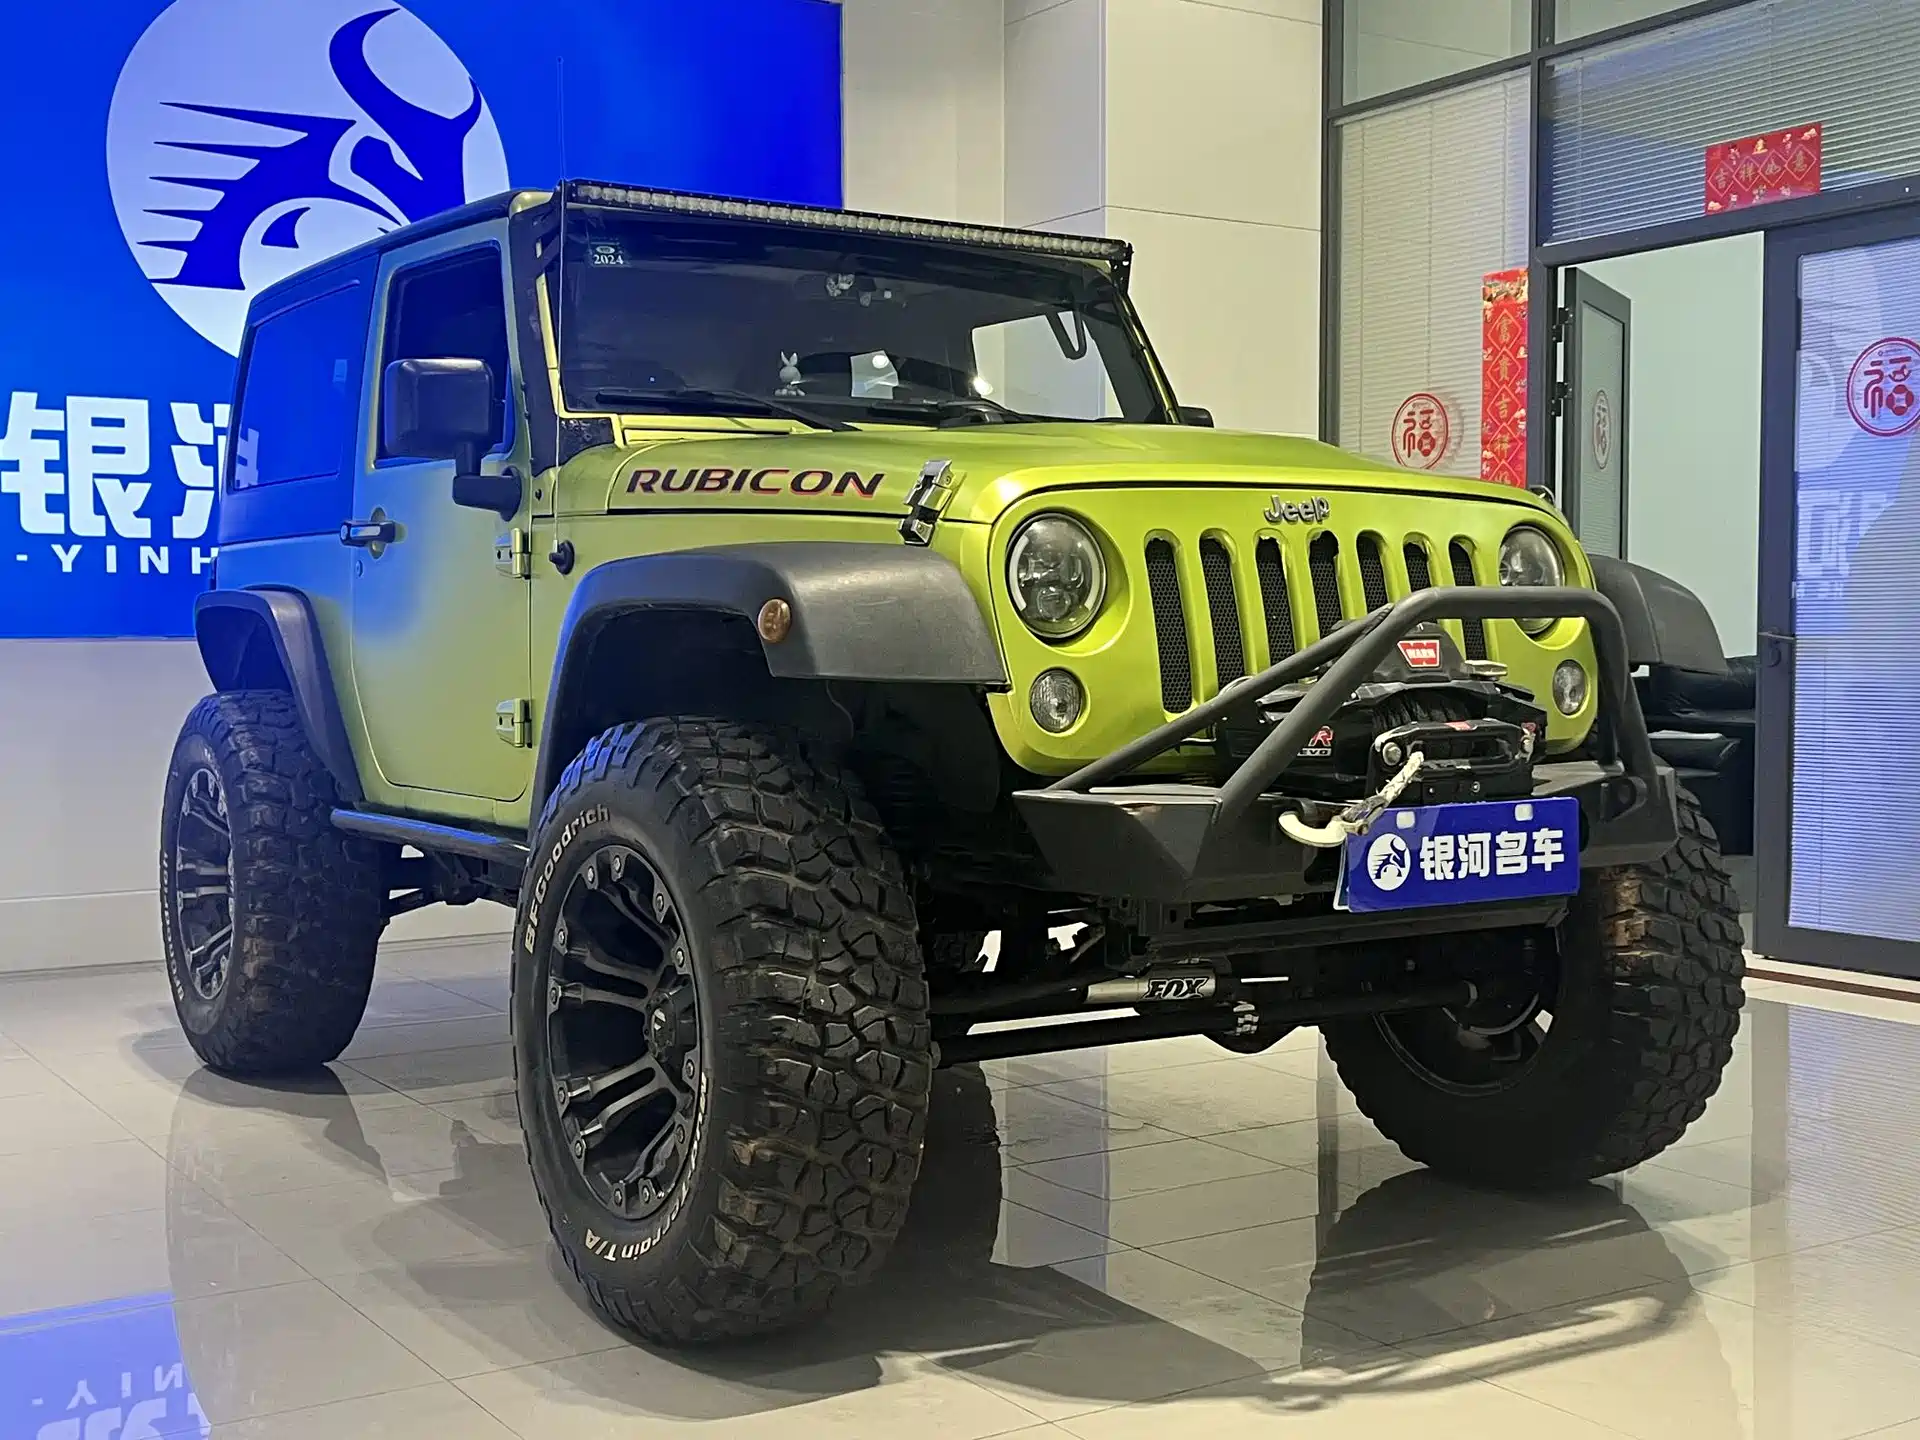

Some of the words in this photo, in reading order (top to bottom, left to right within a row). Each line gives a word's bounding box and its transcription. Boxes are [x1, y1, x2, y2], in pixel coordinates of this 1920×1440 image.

[593, 254, 624, 265] 2024
[625, 468, 885, 498] RUBICON
[1263, 494, 1330, 525] Jeep
[1420, 828, 1565, 881] 银河名车
[524, 803, 610, 955] BFGoodrich
[1143, 976, 1209, 1000] FOX
